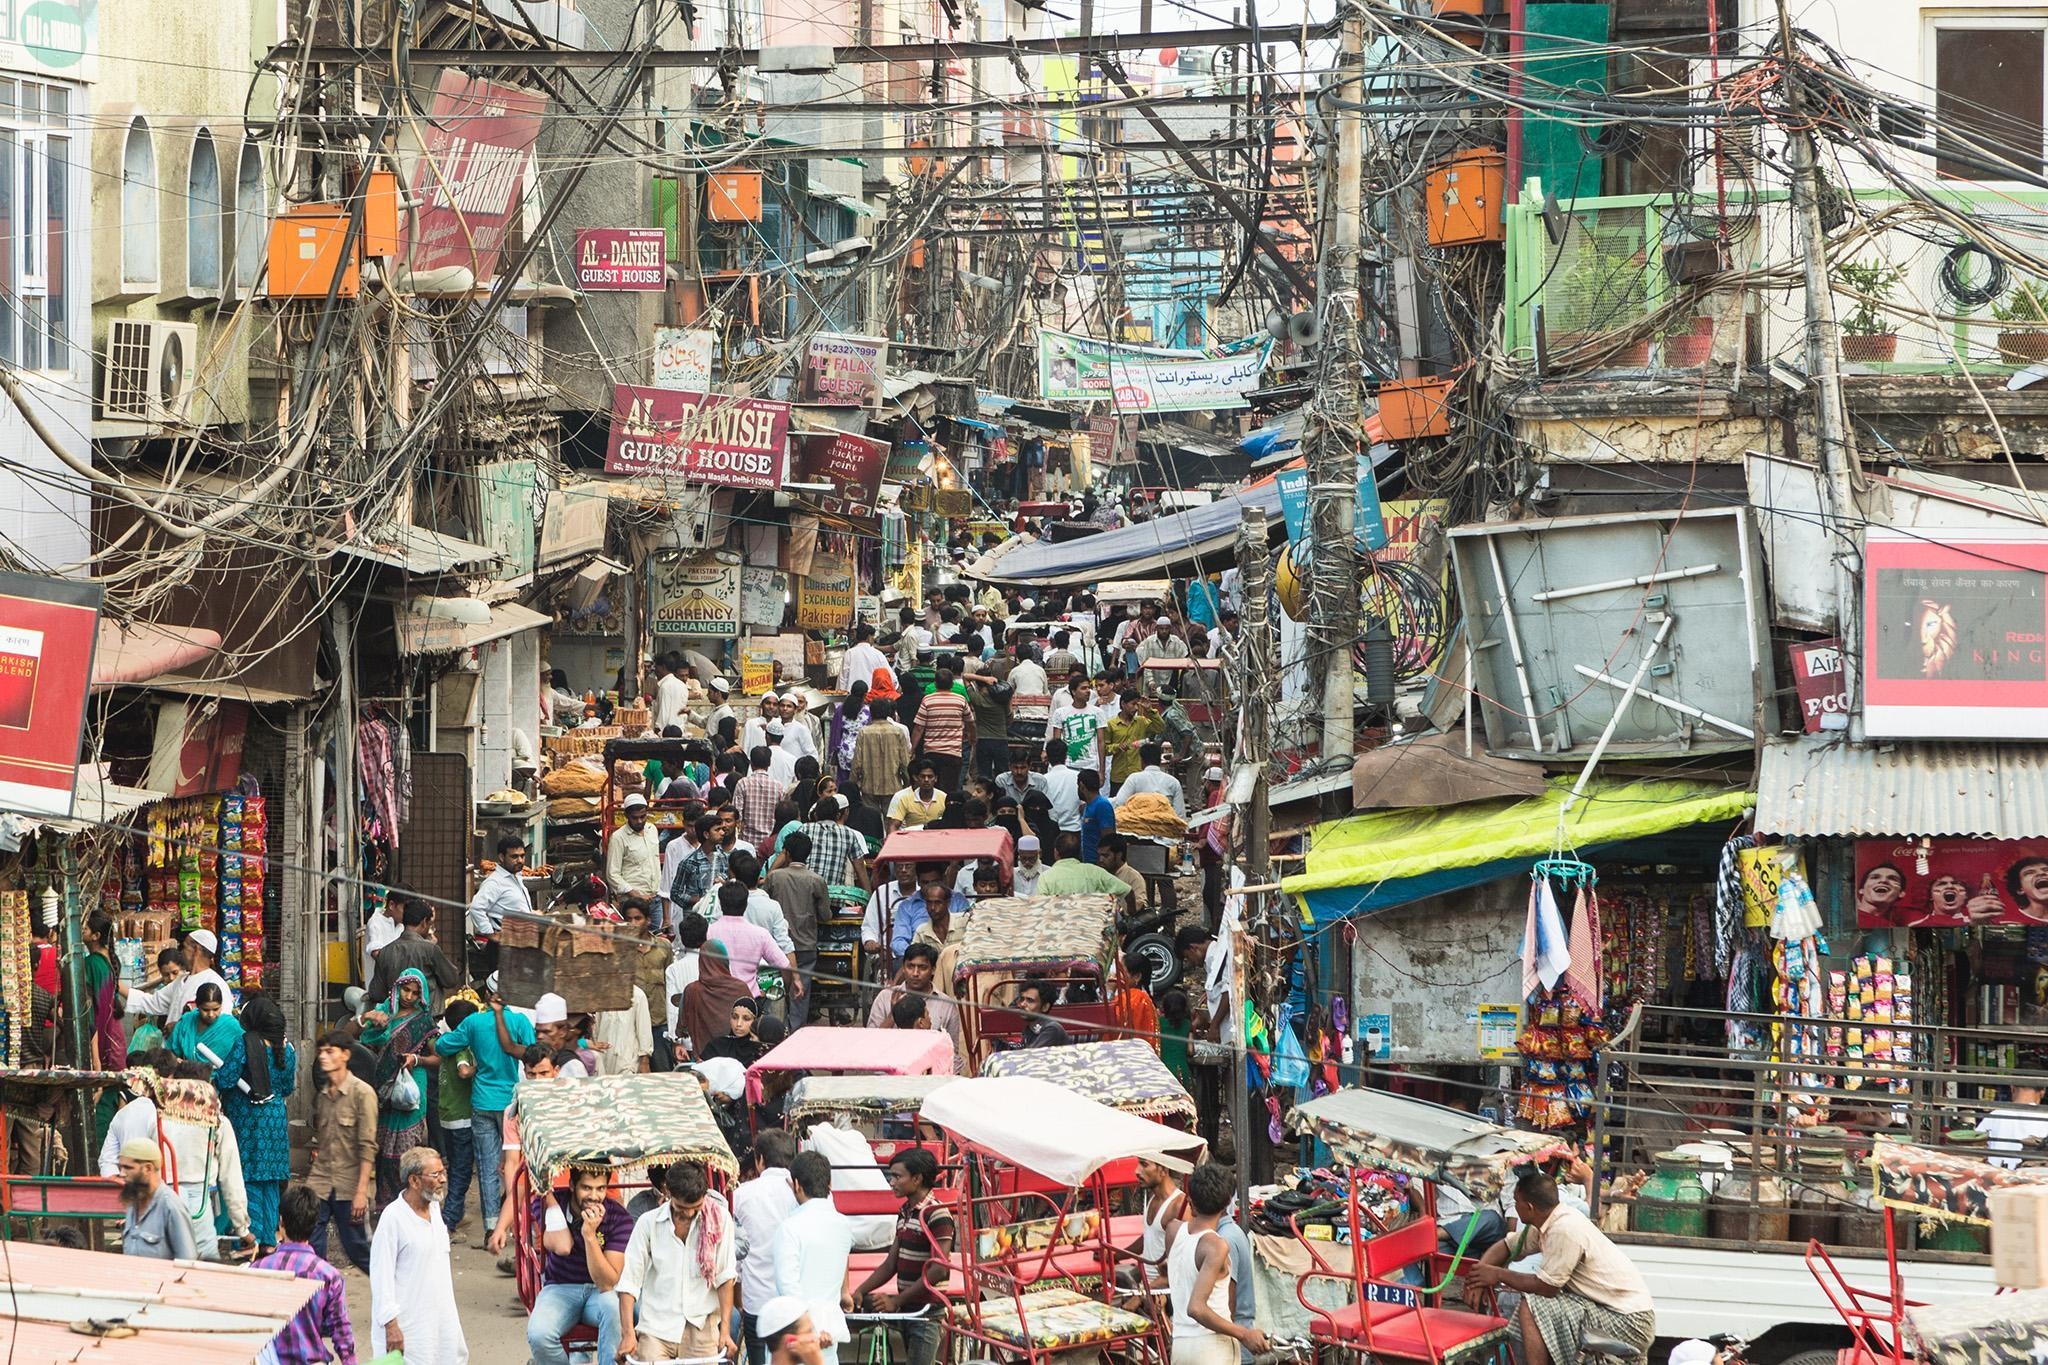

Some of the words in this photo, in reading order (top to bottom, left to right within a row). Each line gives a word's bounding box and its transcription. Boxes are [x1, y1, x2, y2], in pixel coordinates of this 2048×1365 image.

[582, 240, 599, 265] AL
[610, 240, 660, 267] DANISH
[581, 269, 619, 282] GUEST
[622, 270, 661, 283] HOUSE
[1155, 370, 1218, 386] ریستورانت
[1222, 362, 1256, 385] کابلی
[818, 375, 862, 394] GUEST
[622, 398, 656, 437] AL
[678, 402, 775, 450] DANISH
[620, 440, 691, 466] GUEST
[696, 449, 772, 475] HOUSE
[827, 448, 865, 462] chicken
[661, 567, 735, 594] پاکستانی
[803, 577, 851, 592] CURRENCY
[803, 593, 850, 606] EXCHANGER
[658, 608, 733, 620] CURRENCY
[802, 607, 851, 625] Pakistani
[658, 622, 734, 633] EXCHANGER
